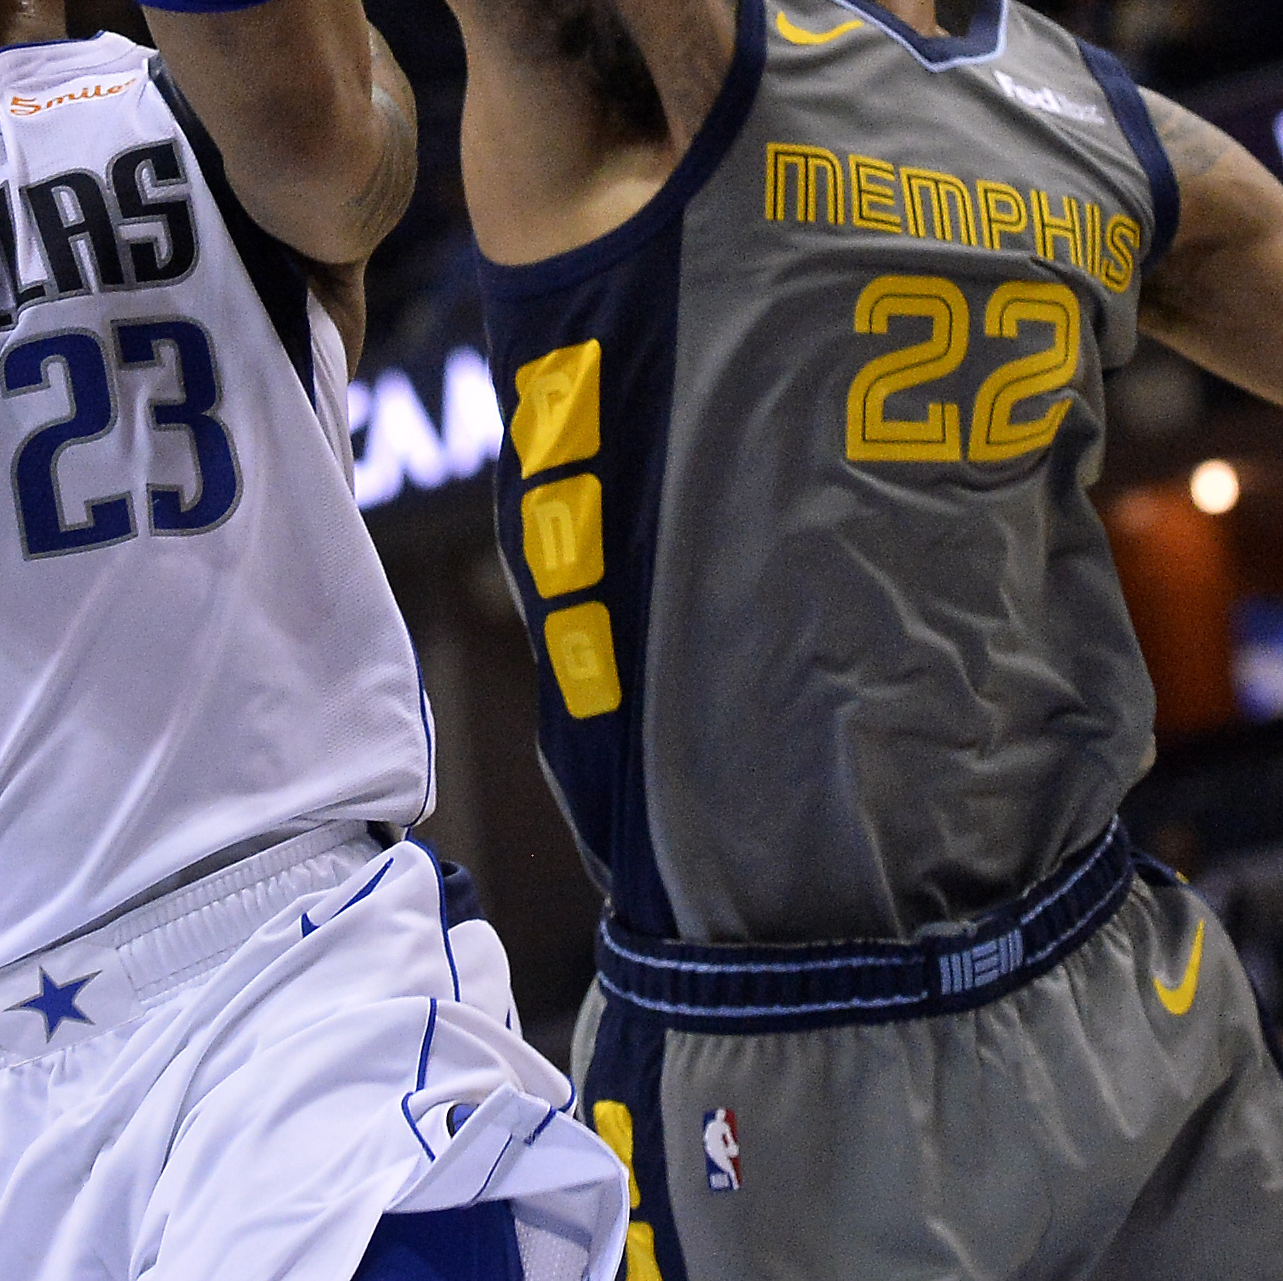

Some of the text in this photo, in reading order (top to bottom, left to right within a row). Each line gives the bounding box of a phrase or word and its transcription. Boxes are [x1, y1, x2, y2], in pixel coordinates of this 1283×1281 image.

[766, 141, 1141, 293] MEMPHIS
[0, 317, 244, 561] 23
[847, 274, 1081, 462] 22
